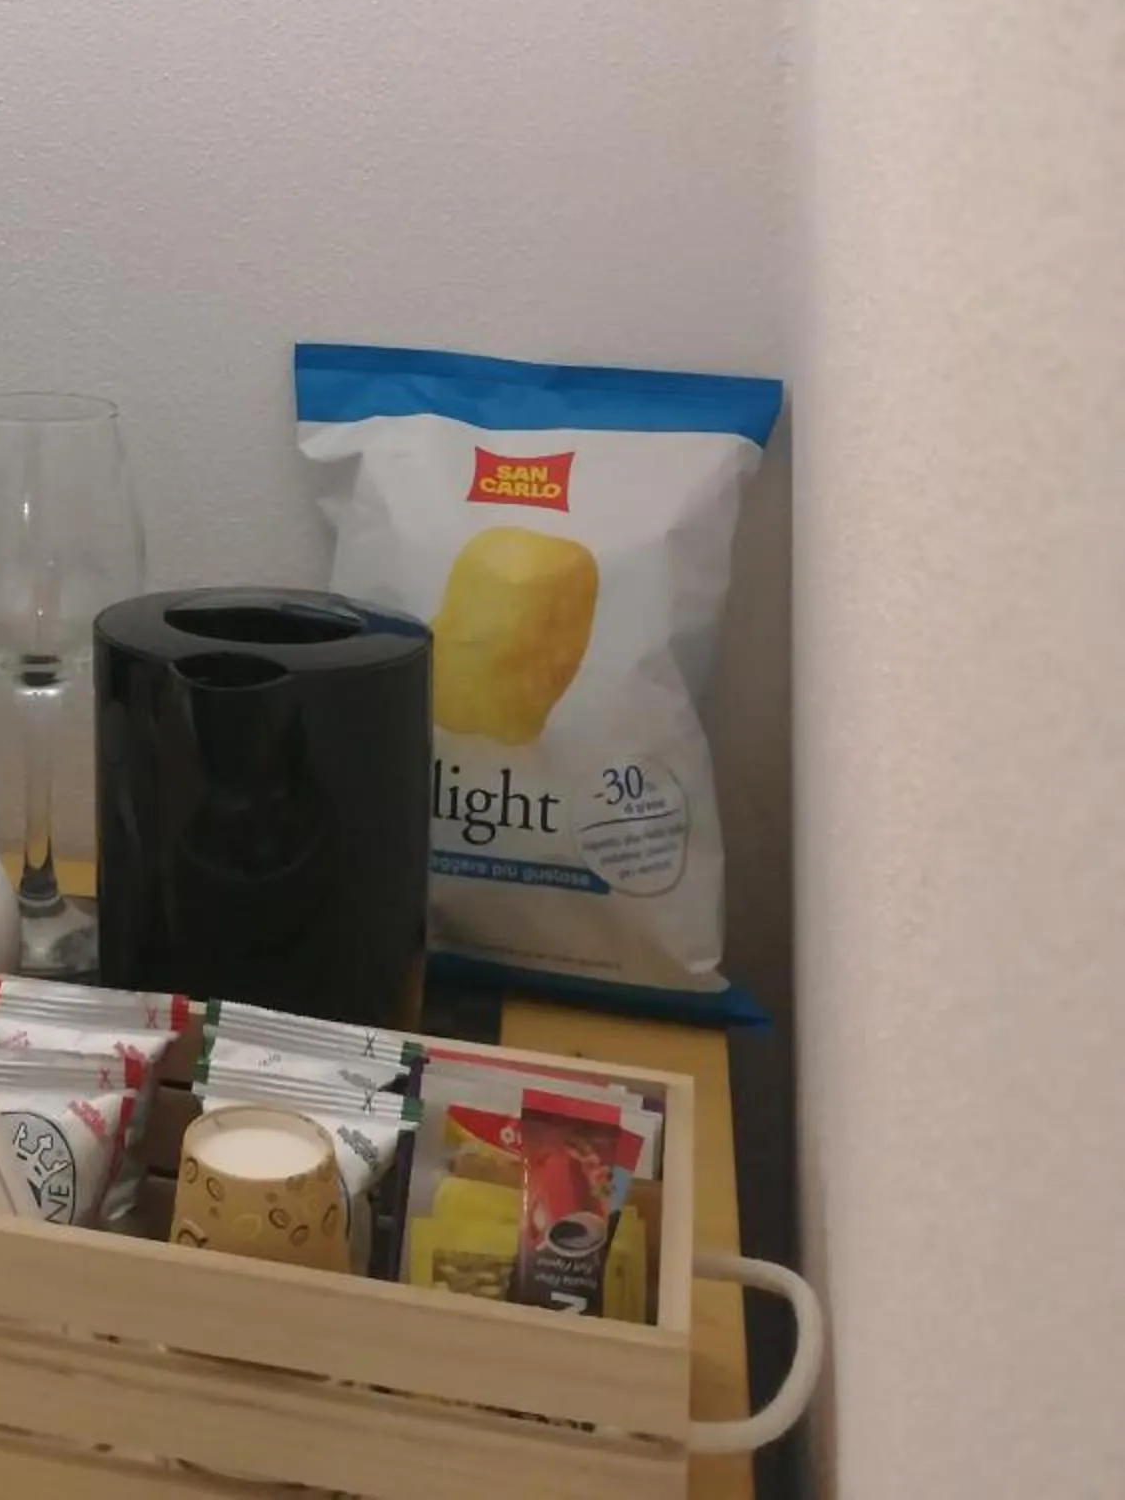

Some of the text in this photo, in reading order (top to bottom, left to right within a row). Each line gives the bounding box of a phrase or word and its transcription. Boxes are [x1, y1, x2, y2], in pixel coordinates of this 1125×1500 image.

[496, 464, 548, 483] SAN
[479, 476, 562, 498] CARLO
[433, 758, 560, 845] light
